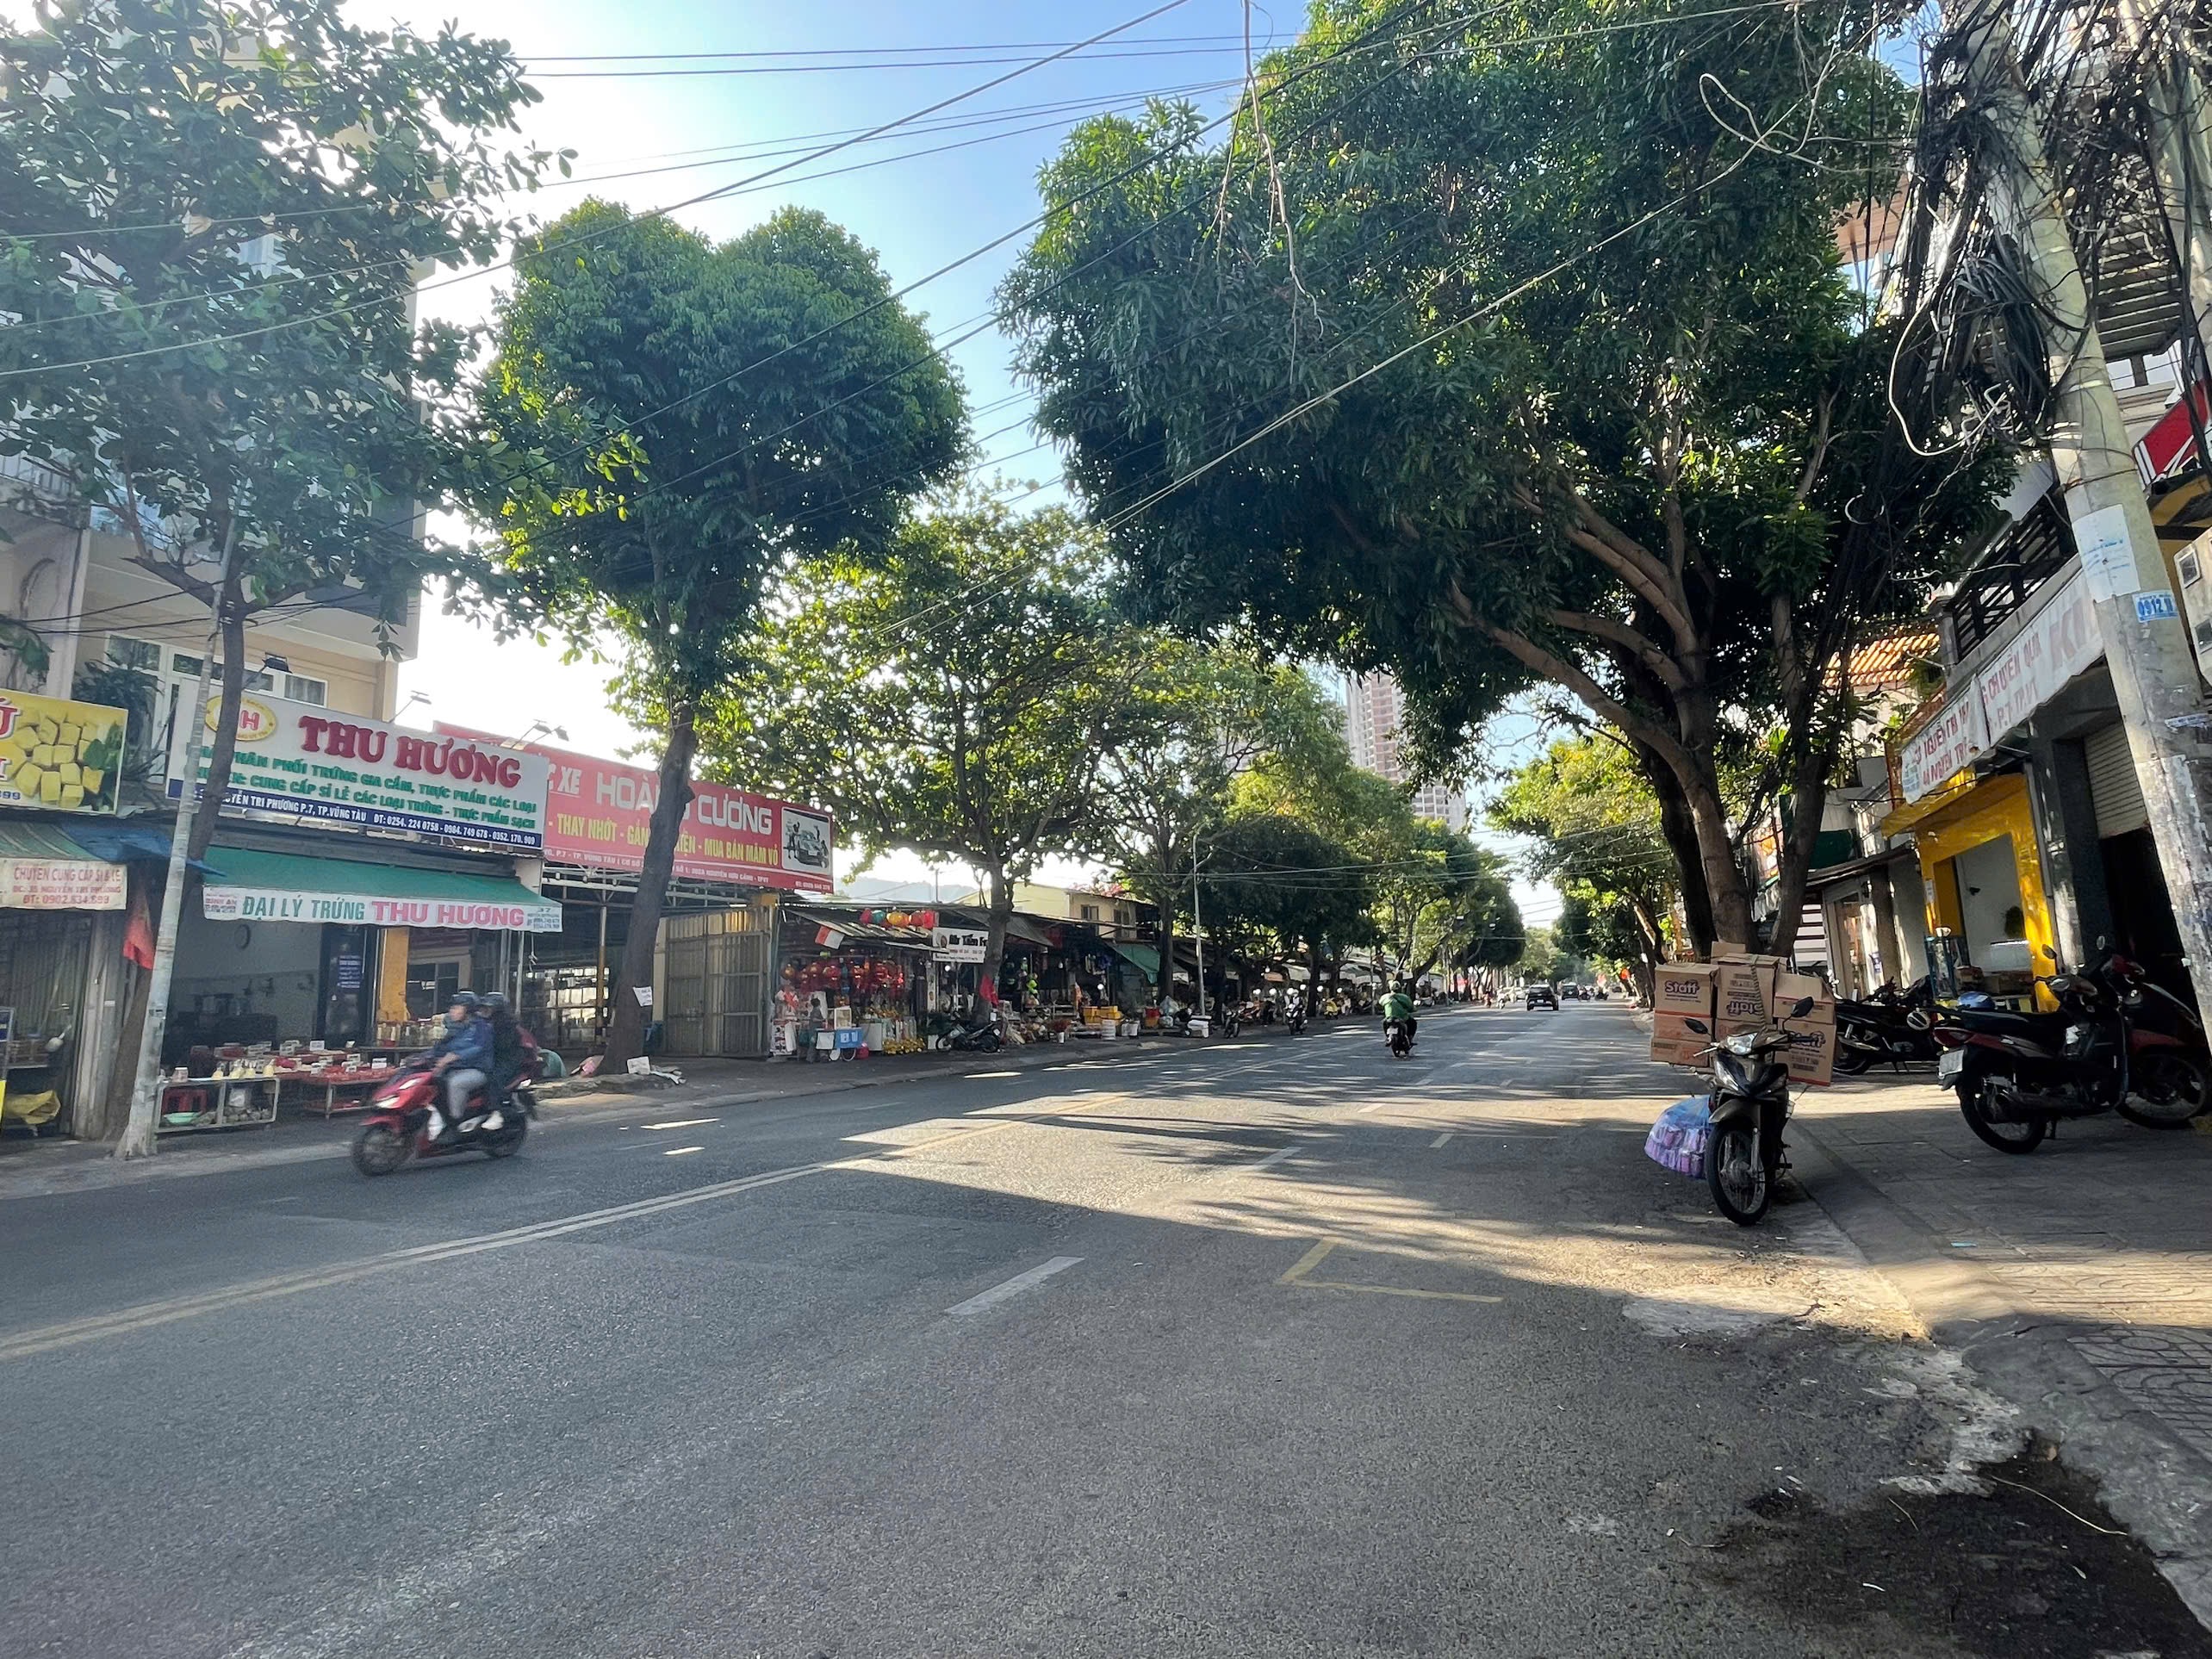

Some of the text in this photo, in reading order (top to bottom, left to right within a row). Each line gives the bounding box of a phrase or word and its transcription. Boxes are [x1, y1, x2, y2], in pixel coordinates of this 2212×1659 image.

[299, 715, 388, 763] THU
[394, 736, 521, 788] HƯƠNG
[234, 751, 269, 767] HÂN
[272, 758, 308, 774] PHỐI
[360, 774, 382, 787] GIA
[488, 795, 511, 809] CÁC
[250, 774, 287, 792] CUNG
[289, 778, 316, 794] CẤP
[353, 790, 377, 805] CÁC
[557, 766, 582, 795] XE
[250, 796, 264, 808] TRI
[265, 798, 299, 812] PHƯƠNG
[351, 808, 367, 822] TÀU
[408, 818, 421, 830] 224
[556, 812, 586, 837] THAY
[587, 816, 618, 842] NHỚT
[704, 837, 724, 858] MUA
[725, 838, 744, 861] BÁN
[242, 895, 275, 921] ĐẠI
[280, 894, 303, 918] LÝ
[311, 896, 366, 921] TRỨNG
[371, 900, 429, 923] THU
[437, 904, 525, 927] HƯƠNG
[1664, 979, 1699, 995] Staff
